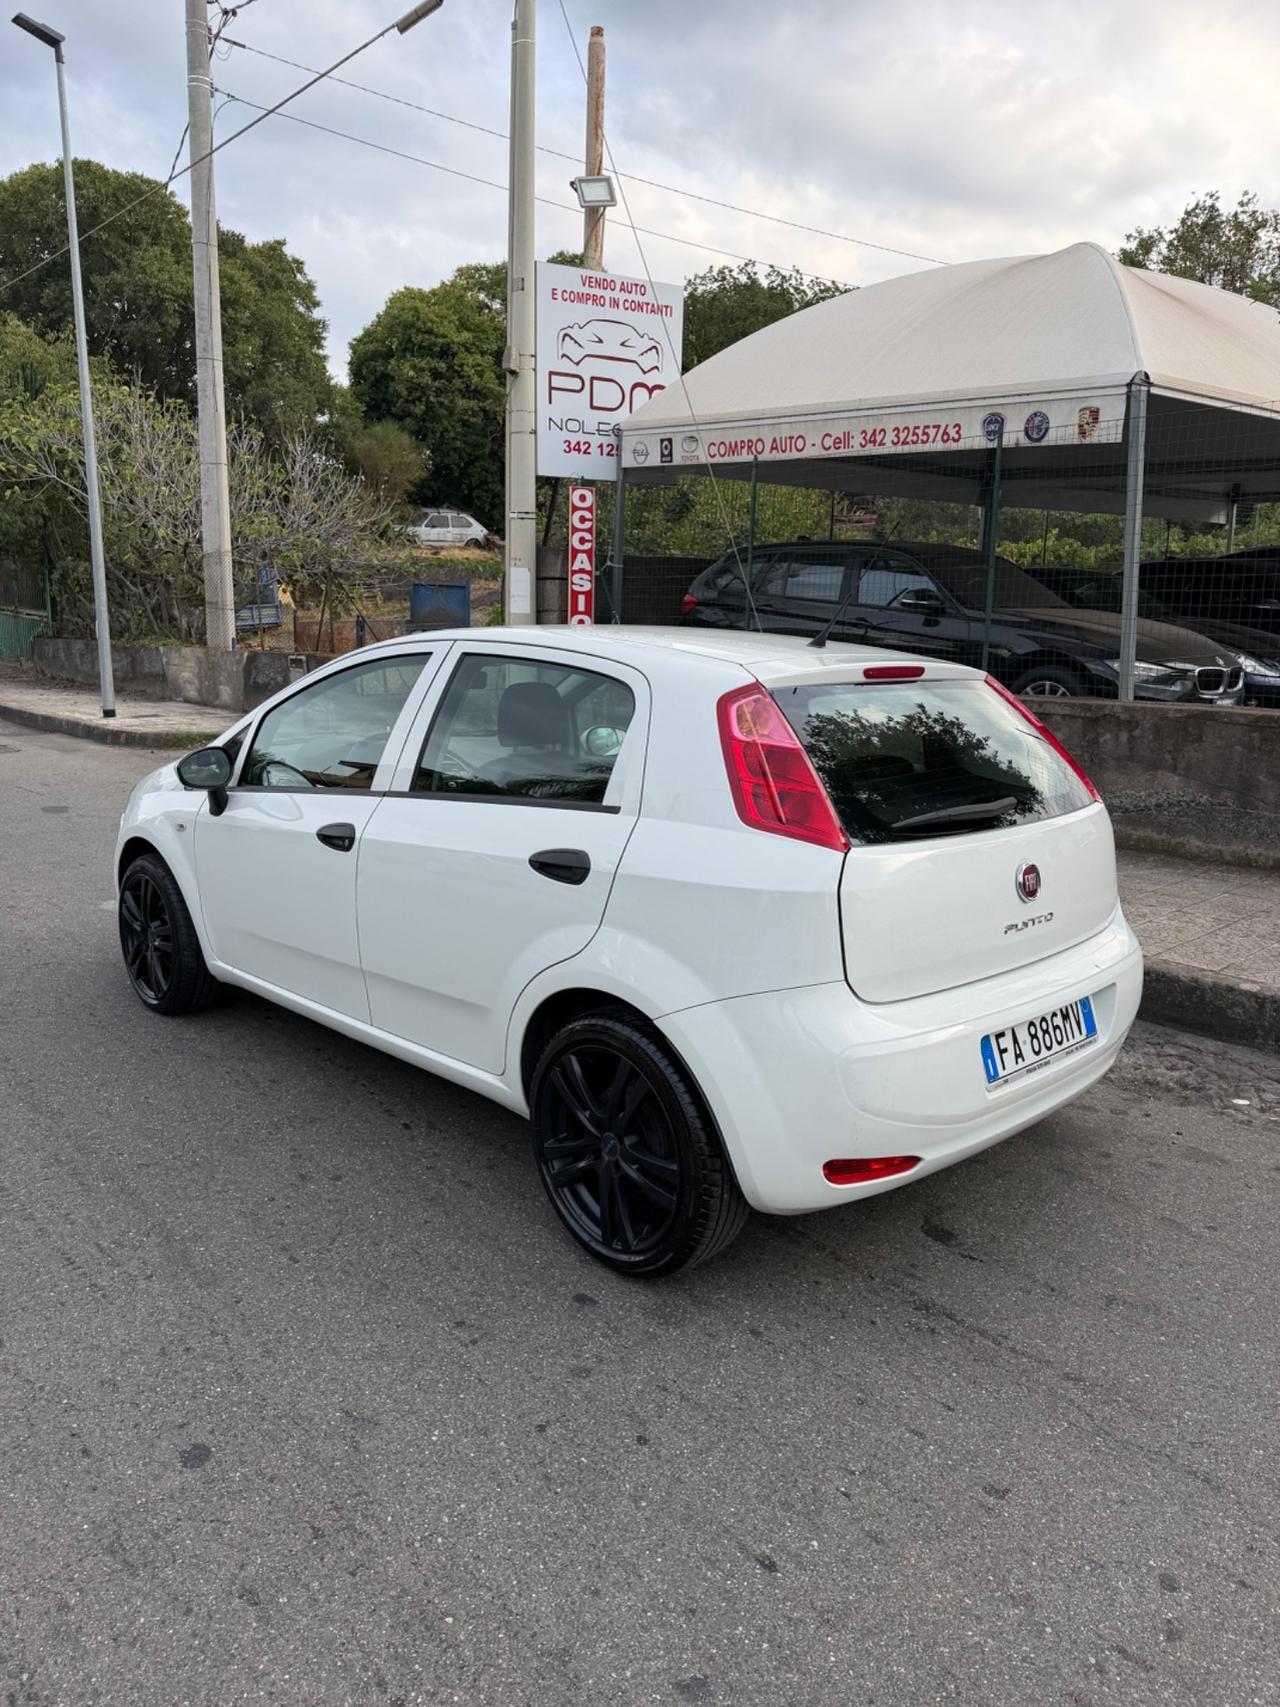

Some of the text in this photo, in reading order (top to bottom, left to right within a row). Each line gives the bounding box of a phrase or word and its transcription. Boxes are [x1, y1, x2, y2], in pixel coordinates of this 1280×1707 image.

[580, 274, 647, 297] VENDO AUTO
[551, 288, 673, 317] E COMPRO IN CONTANTI
[562, 439, 592, 456] 342
[707, 437, 766, 459] COMPRO
[769, 434, 807, 454] AUTO
[821, 431, 855, 451] Cell:
[859, 427, 887, 449] 342
[891, 422, 962, 446] 3255763
[994, 1000, 1083, 1071] FA 886MV
